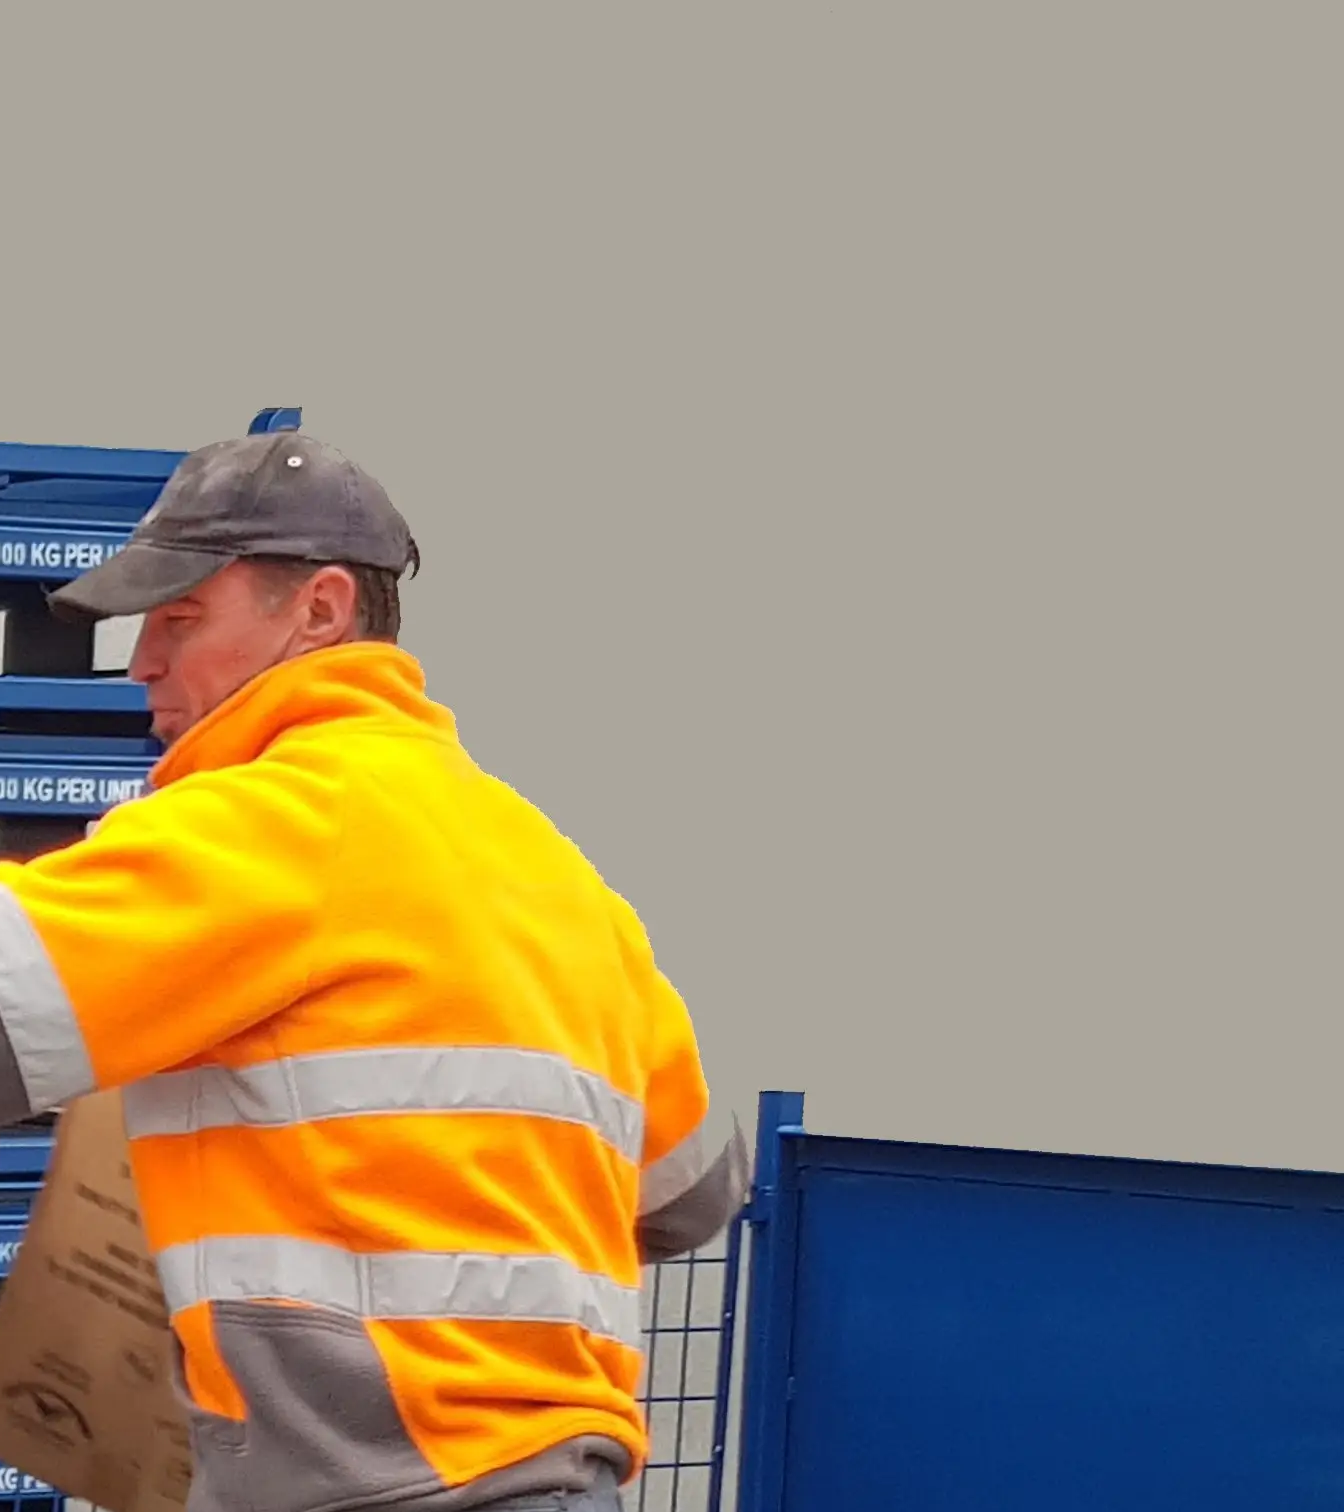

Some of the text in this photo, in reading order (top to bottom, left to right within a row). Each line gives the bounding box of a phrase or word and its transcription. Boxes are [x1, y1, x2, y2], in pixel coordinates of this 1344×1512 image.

[31, 543, 60, 567] KG
[64, 543, 103, 568] PER
[23, 777, 55, 802] KG
[56, 777, 95, 803] PER
[99, 778, 146, 802] UNIT
